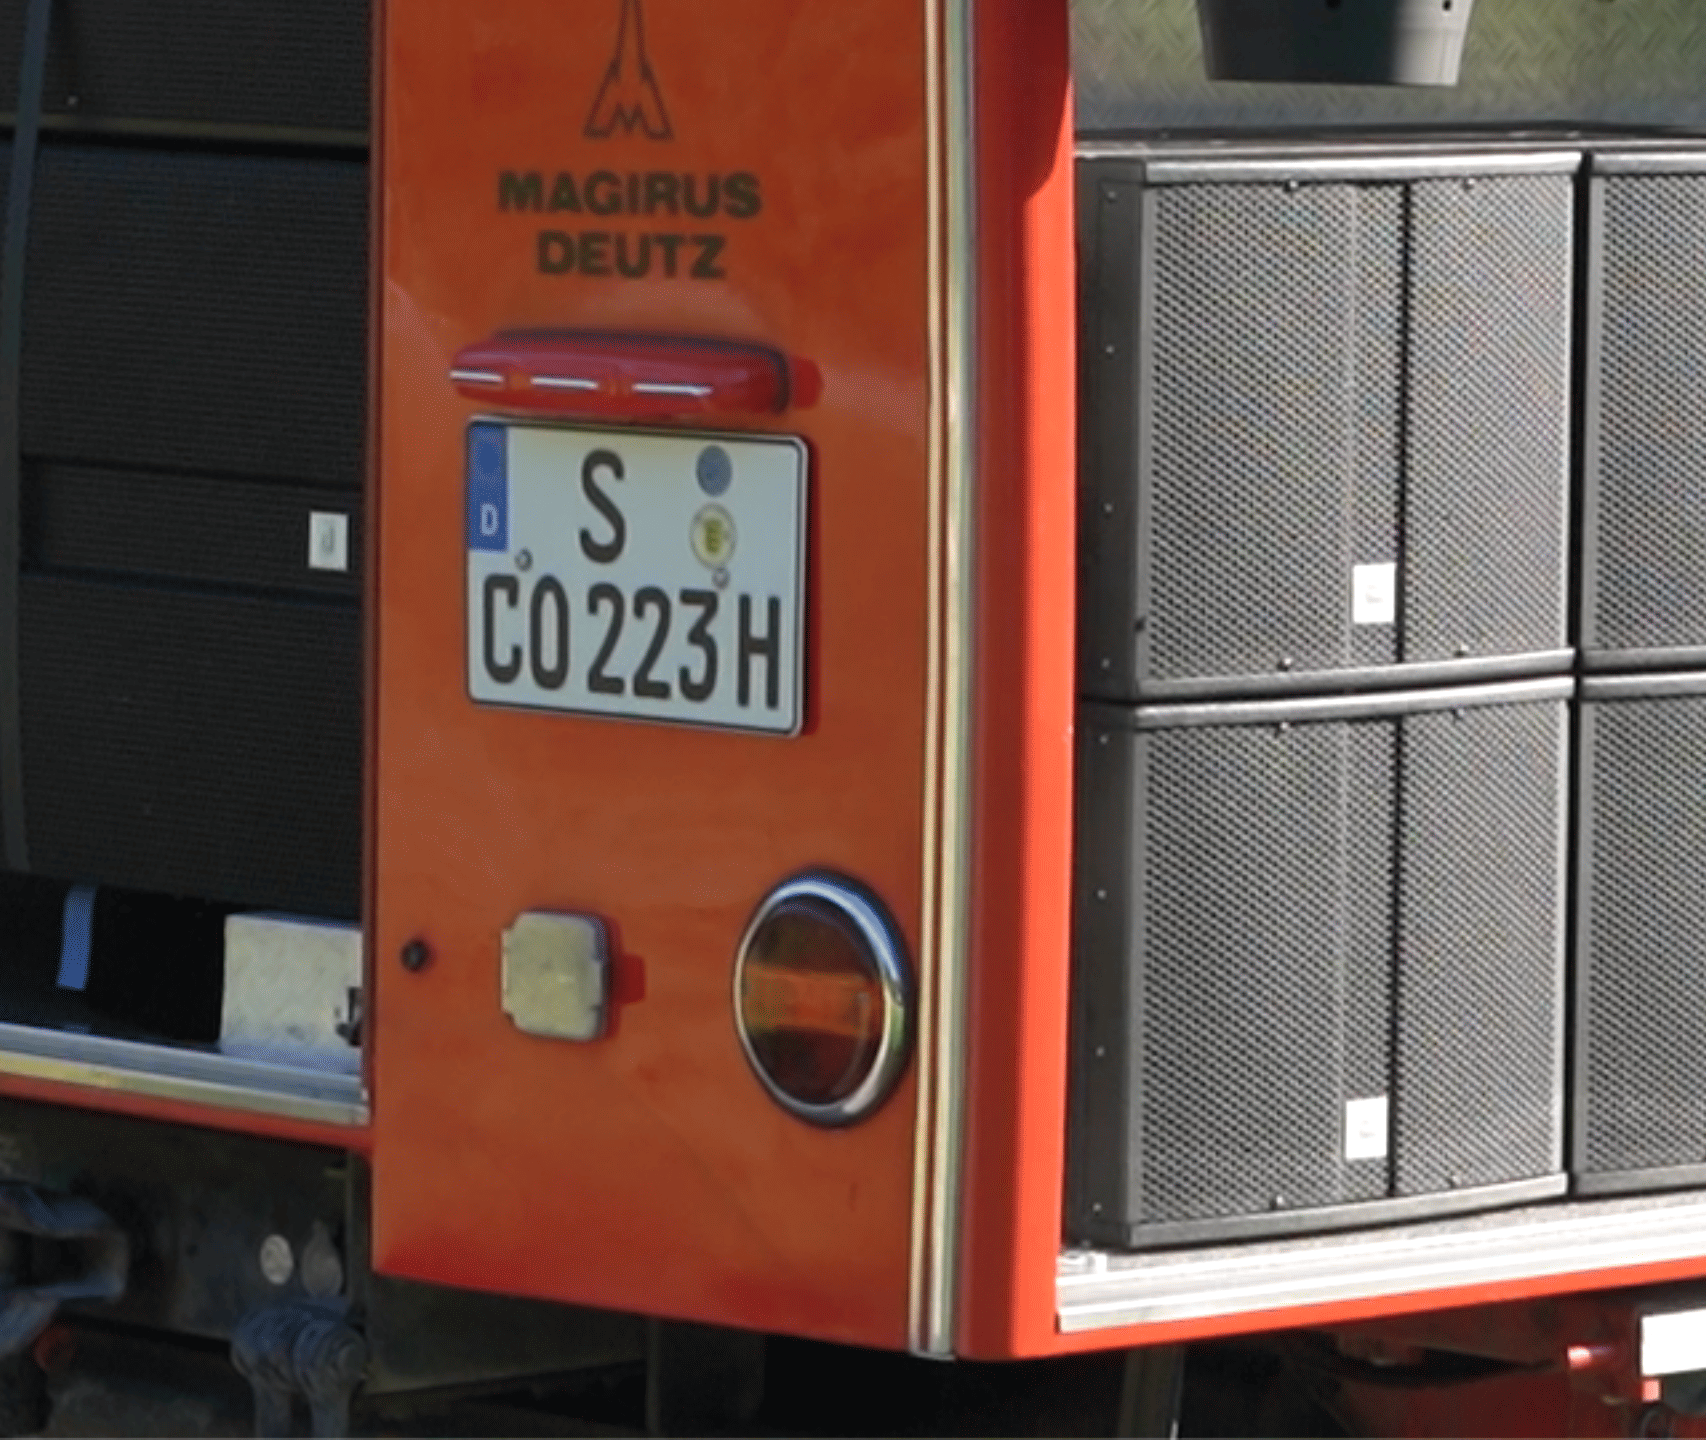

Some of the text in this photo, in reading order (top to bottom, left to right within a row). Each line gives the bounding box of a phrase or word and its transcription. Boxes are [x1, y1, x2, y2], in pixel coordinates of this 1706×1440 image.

[498, 170, 762, 220] MAGIRUS
[536, 229, 727, 280] DEUTZ
[480, 503, 499, 536] D
[578, 447, 627, 564] S
